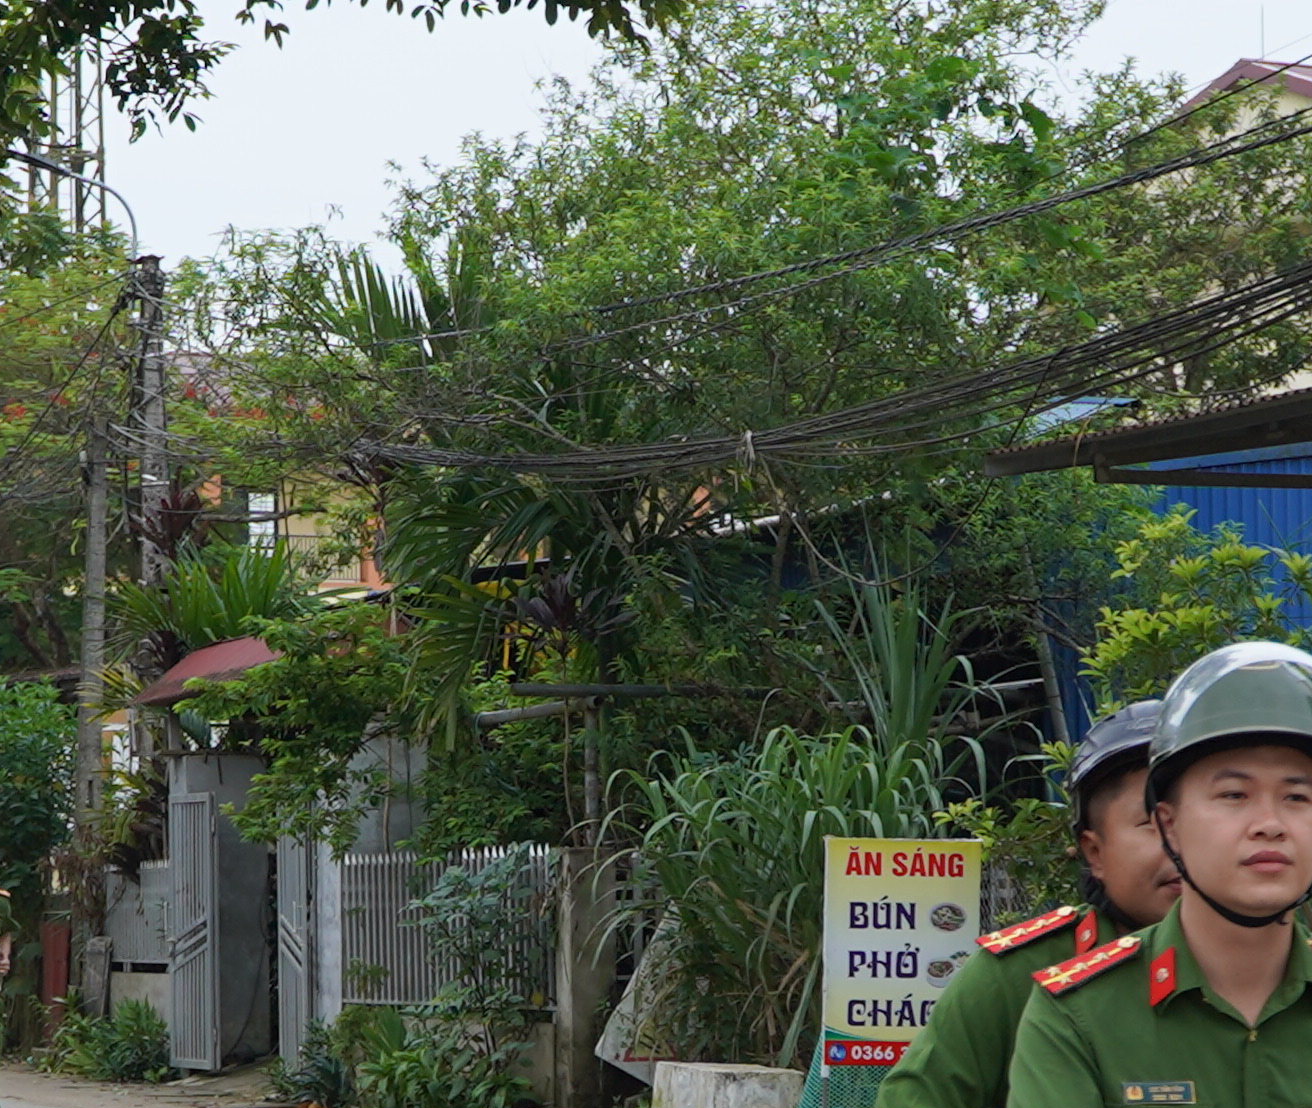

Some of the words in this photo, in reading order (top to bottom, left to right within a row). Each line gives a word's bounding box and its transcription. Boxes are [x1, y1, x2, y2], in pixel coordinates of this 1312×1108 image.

[845, 846, 882, 876] ĂN
[892, 847, 964, 878] SÁNG
[849, 895, 916, 930] BÚN
[848, 943, 920, 979] PHỞ
[851, 1045, 895, 1061] 0366
